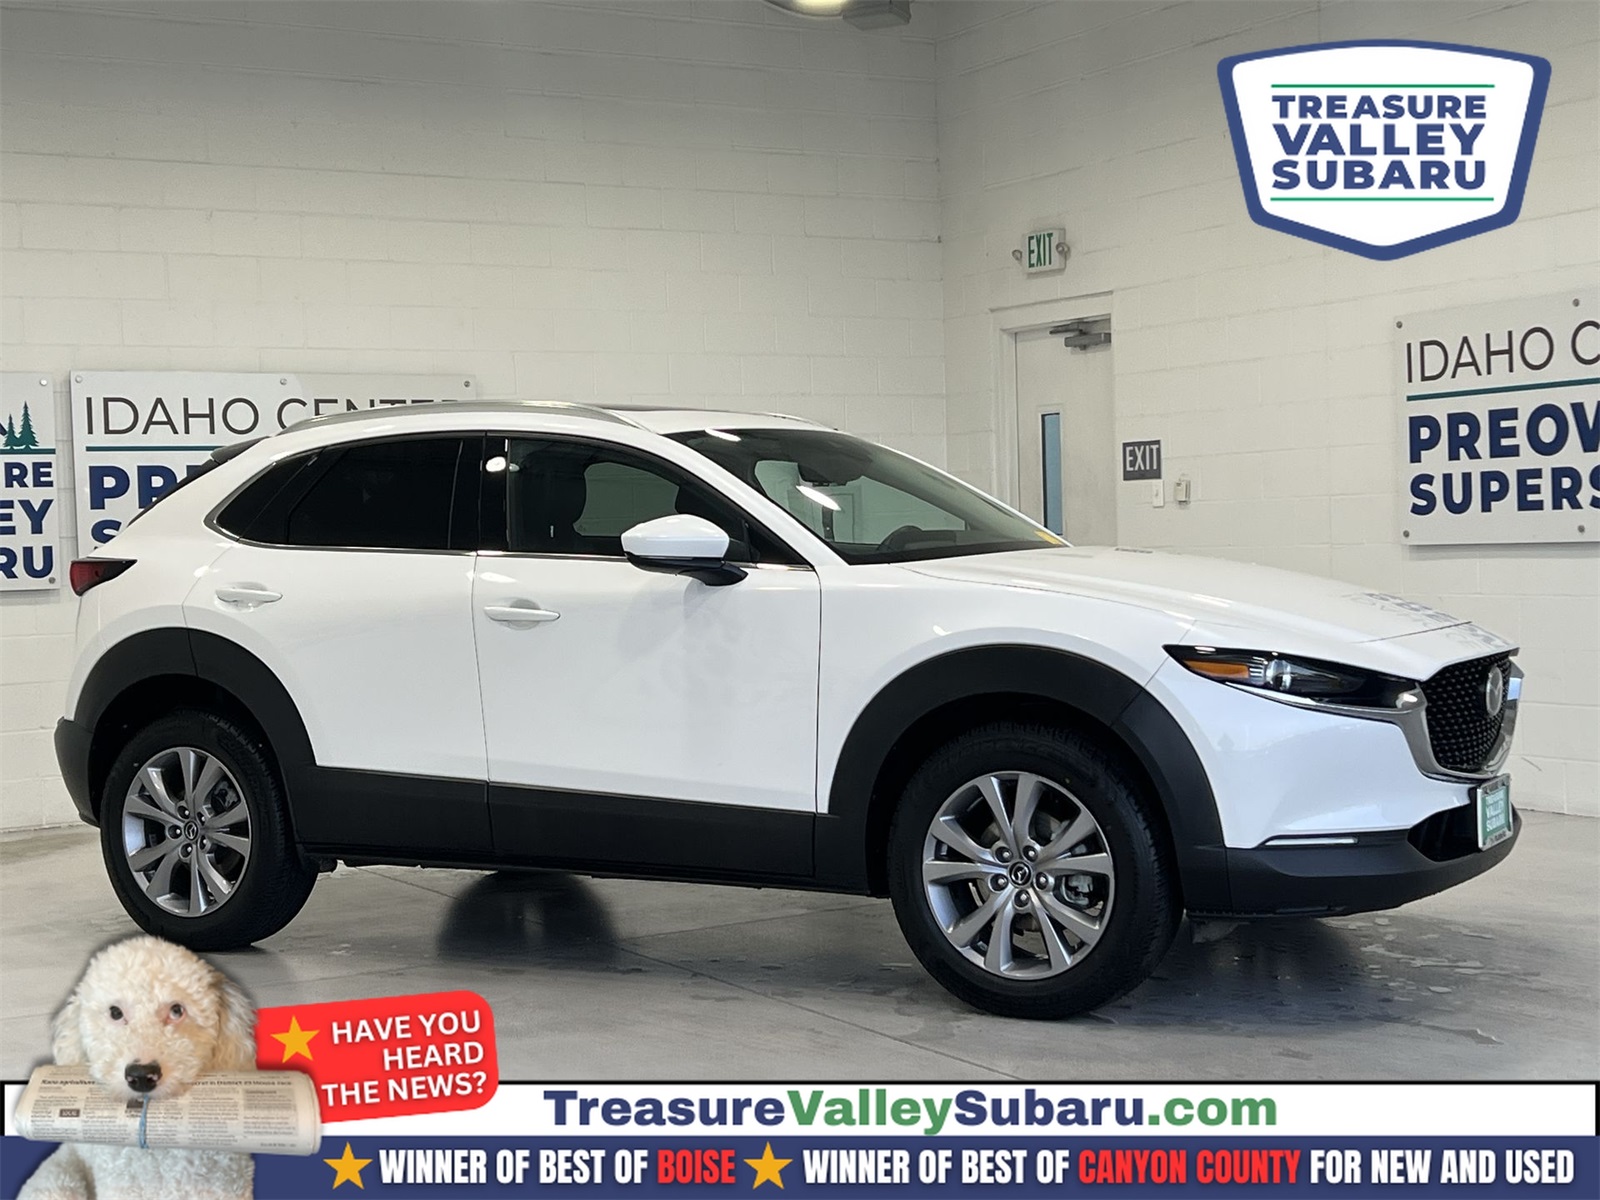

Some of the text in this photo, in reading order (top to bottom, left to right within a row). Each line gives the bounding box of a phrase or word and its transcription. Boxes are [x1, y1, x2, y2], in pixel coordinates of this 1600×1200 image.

[1027, 232, 1054, 268] EXIT
[1406, 326, 1555, 384] IDAHO
[85, 396, 260, 436] IDAHO
[1125, 443, 1161, 472] EXIT
